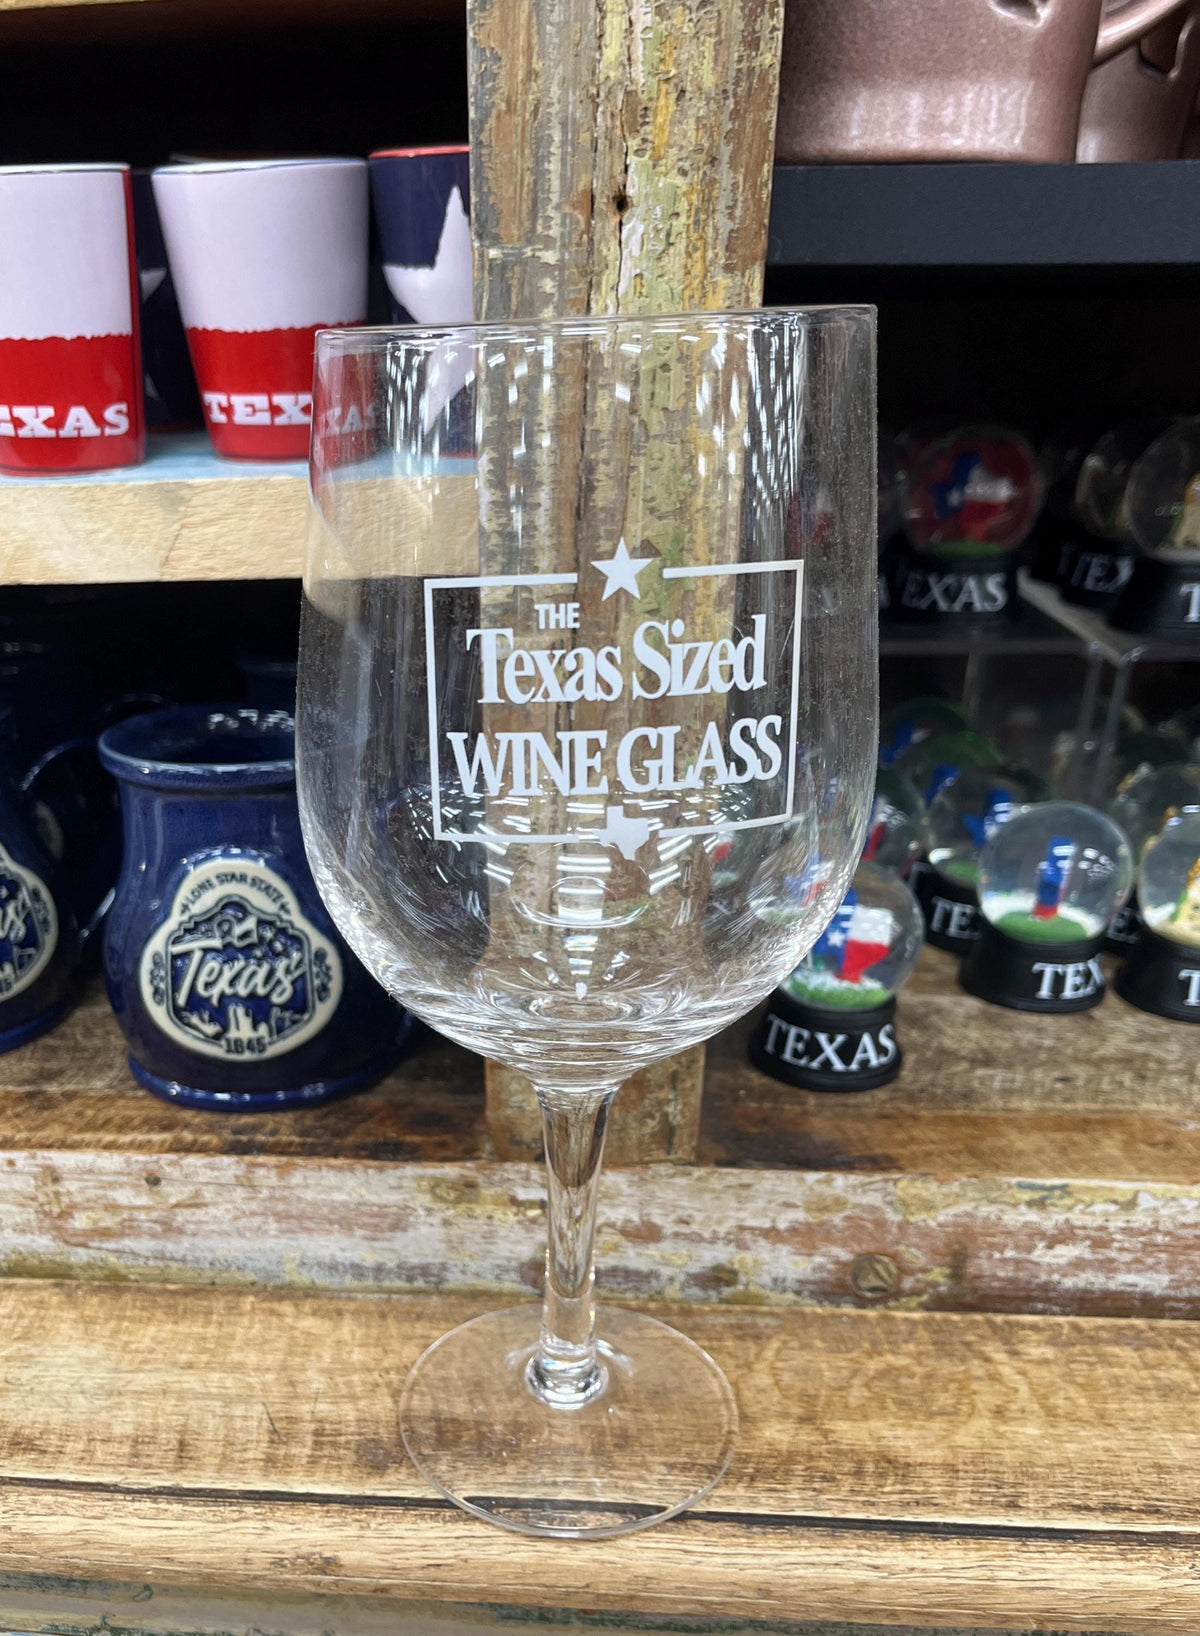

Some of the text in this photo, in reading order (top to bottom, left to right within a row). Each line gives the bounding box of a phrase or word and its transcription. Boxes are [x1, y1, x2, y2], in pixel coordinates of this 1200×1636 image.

[534, 602, 580, 629] THE
[466, 614, 768, 704] Texas Sized
[446, 715, 783, 797] WINE GLASS
[186, 872, 284, 905] LONE STAR STATE
[170, 935, 306, 1008] Texas
[223, 1035, 268, 1055] 1845
[764, 1013, 898, 1073] TEXAS
